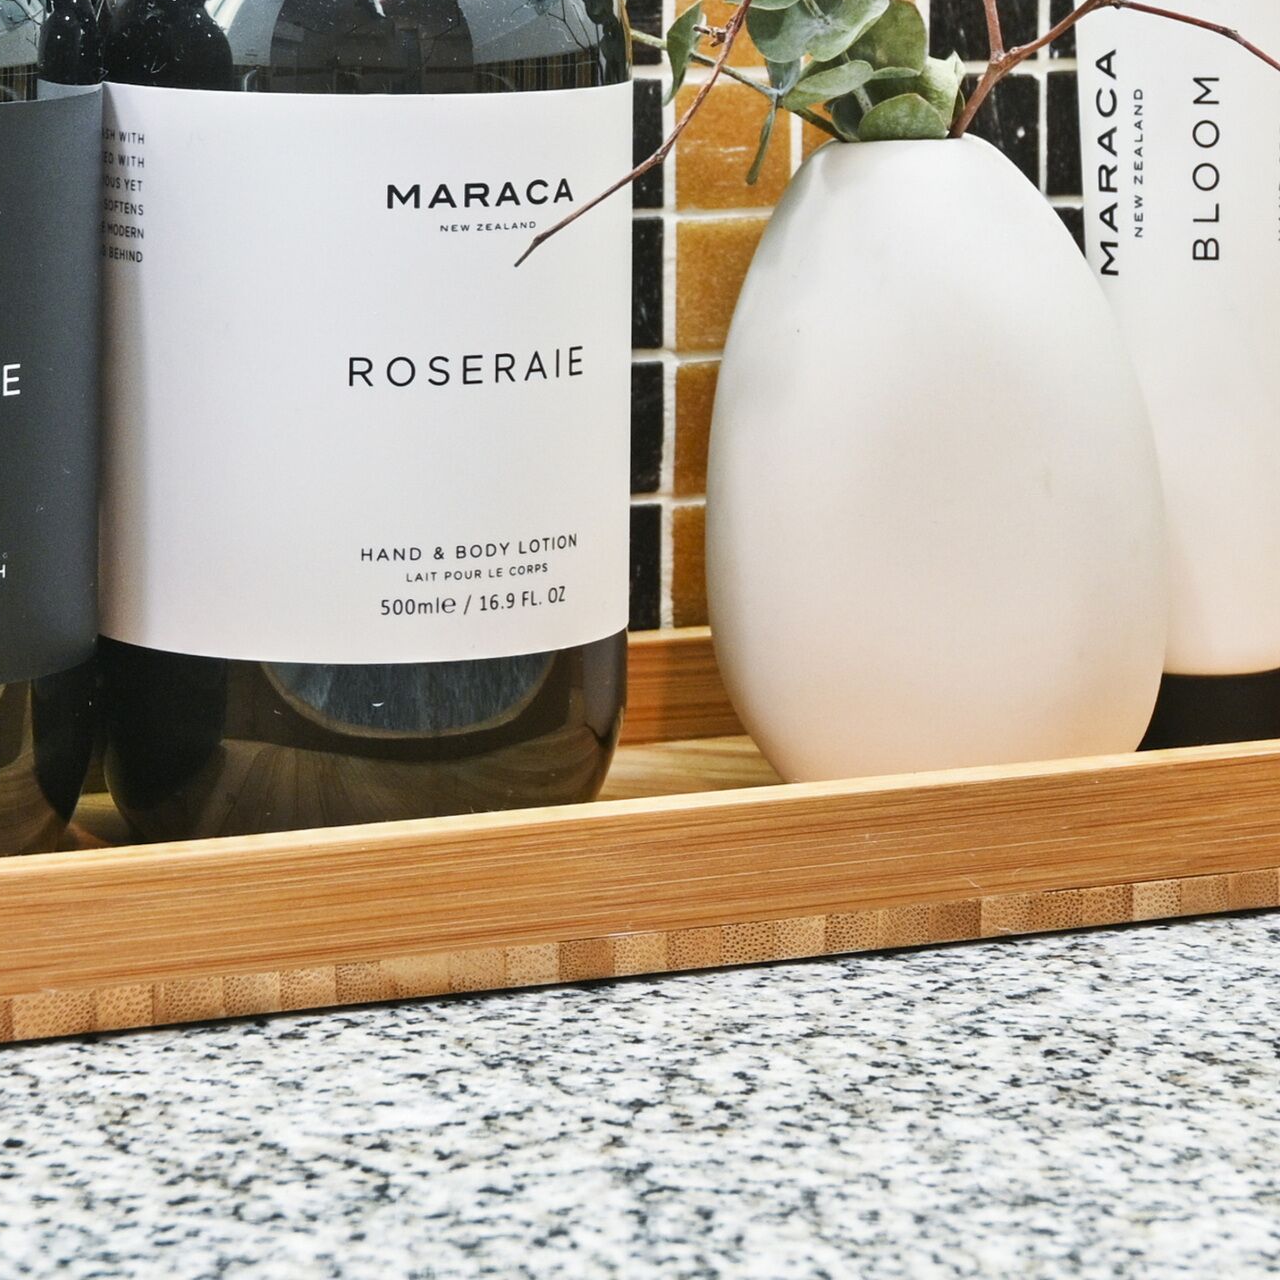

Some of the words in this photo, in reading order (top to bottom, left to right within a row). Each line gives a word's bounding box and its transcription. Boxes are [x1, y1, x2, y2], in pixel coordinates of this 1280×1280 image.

[118, 130, 145, 145] WITH
[1133, 88, 1144, 185] ZEALAND
[117, 153, 145, 168] WITH
[1095, 49, 1120, 277] MARACA
[1191, 76, 1221, 261] BLOOM
[123, 178, 143, 192] YET
[386, 177, 574, 210] MARACA
[103, 198, 144, 216] SOFTENS
[1133, 194, 1144, 238] NEW
[107, 223, 145, 239] MODERN
[439, 224, 470, 233] NEW
[476, 220, 537, 232] ZEALAND
[109, 246, 144, 263] BEHIND
[348, 345, 584, 388] ROSERAIE
[360, 547, 422, 562] HAND
[433, 546, 445, 561] &
[455, 541, 510, 560] BODY
[518, 533, 577, 555] LOTION
[406, 571, 438, 583] LAIT
[444, 569, 482, 581] POUR
[488, 567, 503, 579] LE
[508, 562, 548, 577] CORPS
[463, 594, 472, 616] /
[479, 592, 515, 612] 16.9
[521, 590, 542, 607] FL.
[547, 585, 566, 604] OZ
